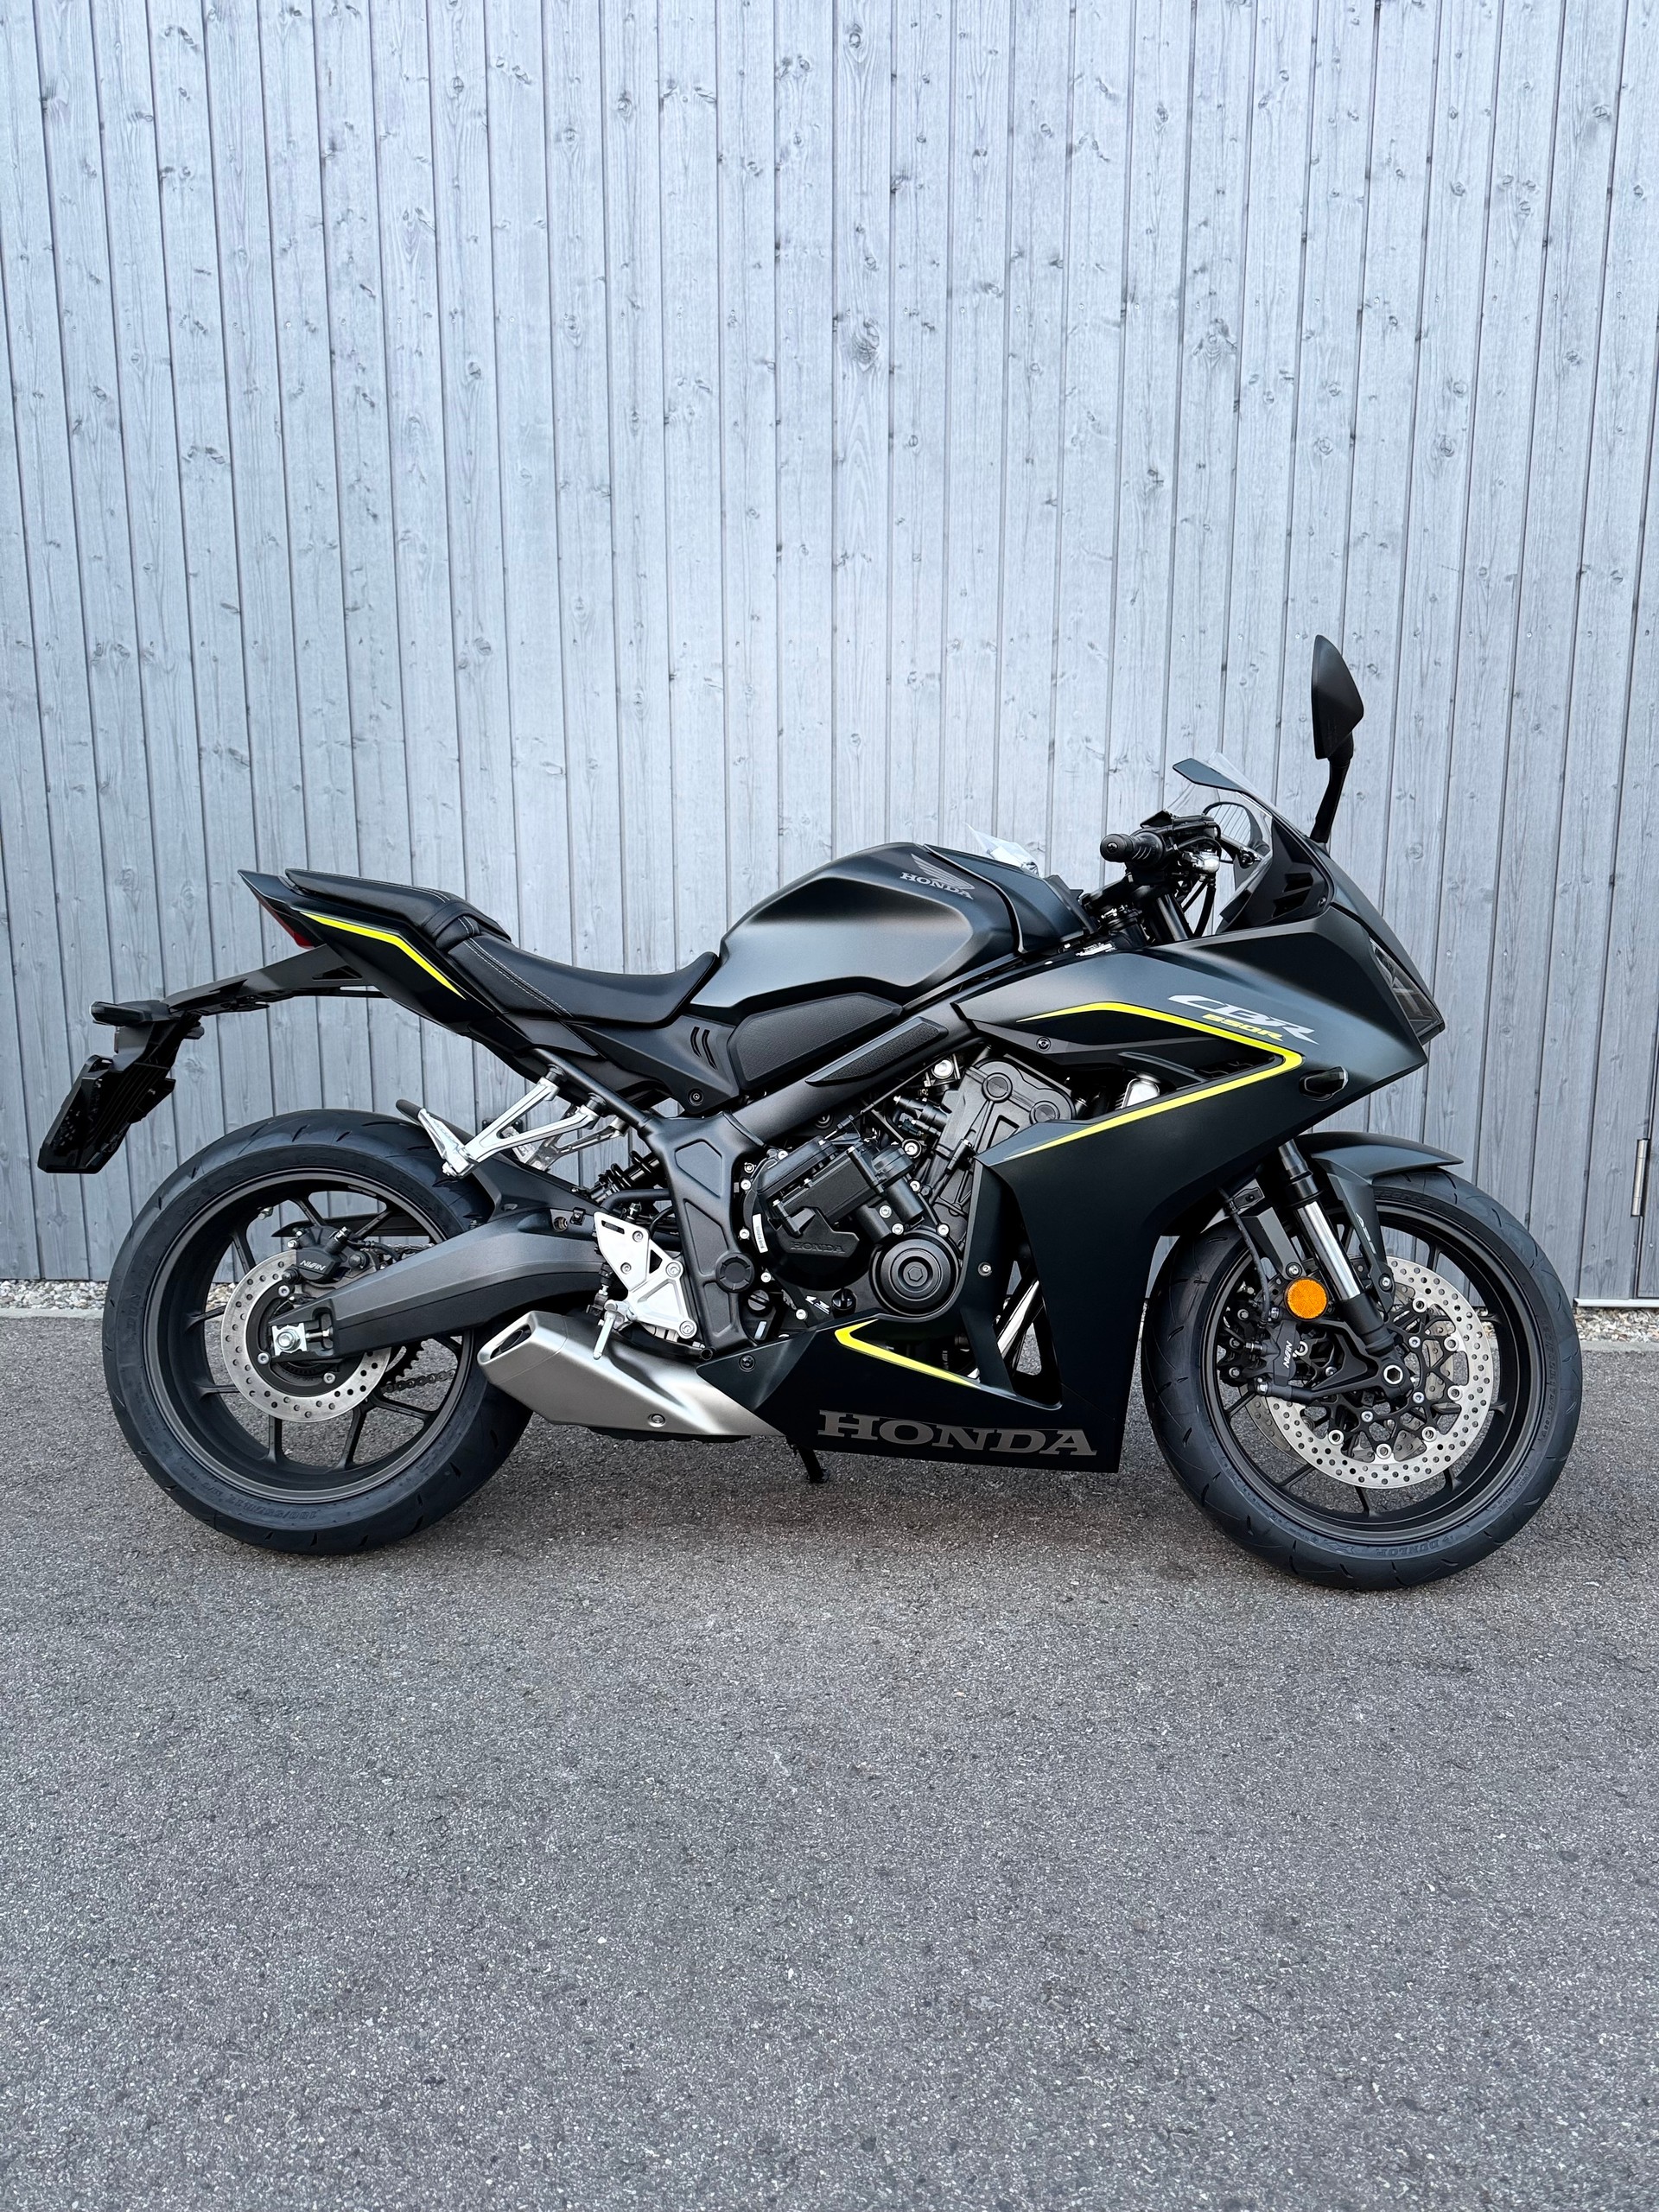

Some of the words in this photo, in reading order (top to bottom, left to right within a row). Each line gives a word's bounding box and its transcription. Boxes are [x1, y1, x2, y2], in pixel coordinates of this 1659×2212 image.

[899, 872, 974, 900] HONDA
[1168, 995, 1320, 1045] CBR
[1202, 1014, 1284, 1042] 650R
[790, 1241, 846, 1254] HONDA
[817, 1409, 1097, 1456] HONDA
[1376, 1539, 1440, 1557] DUNLOP
